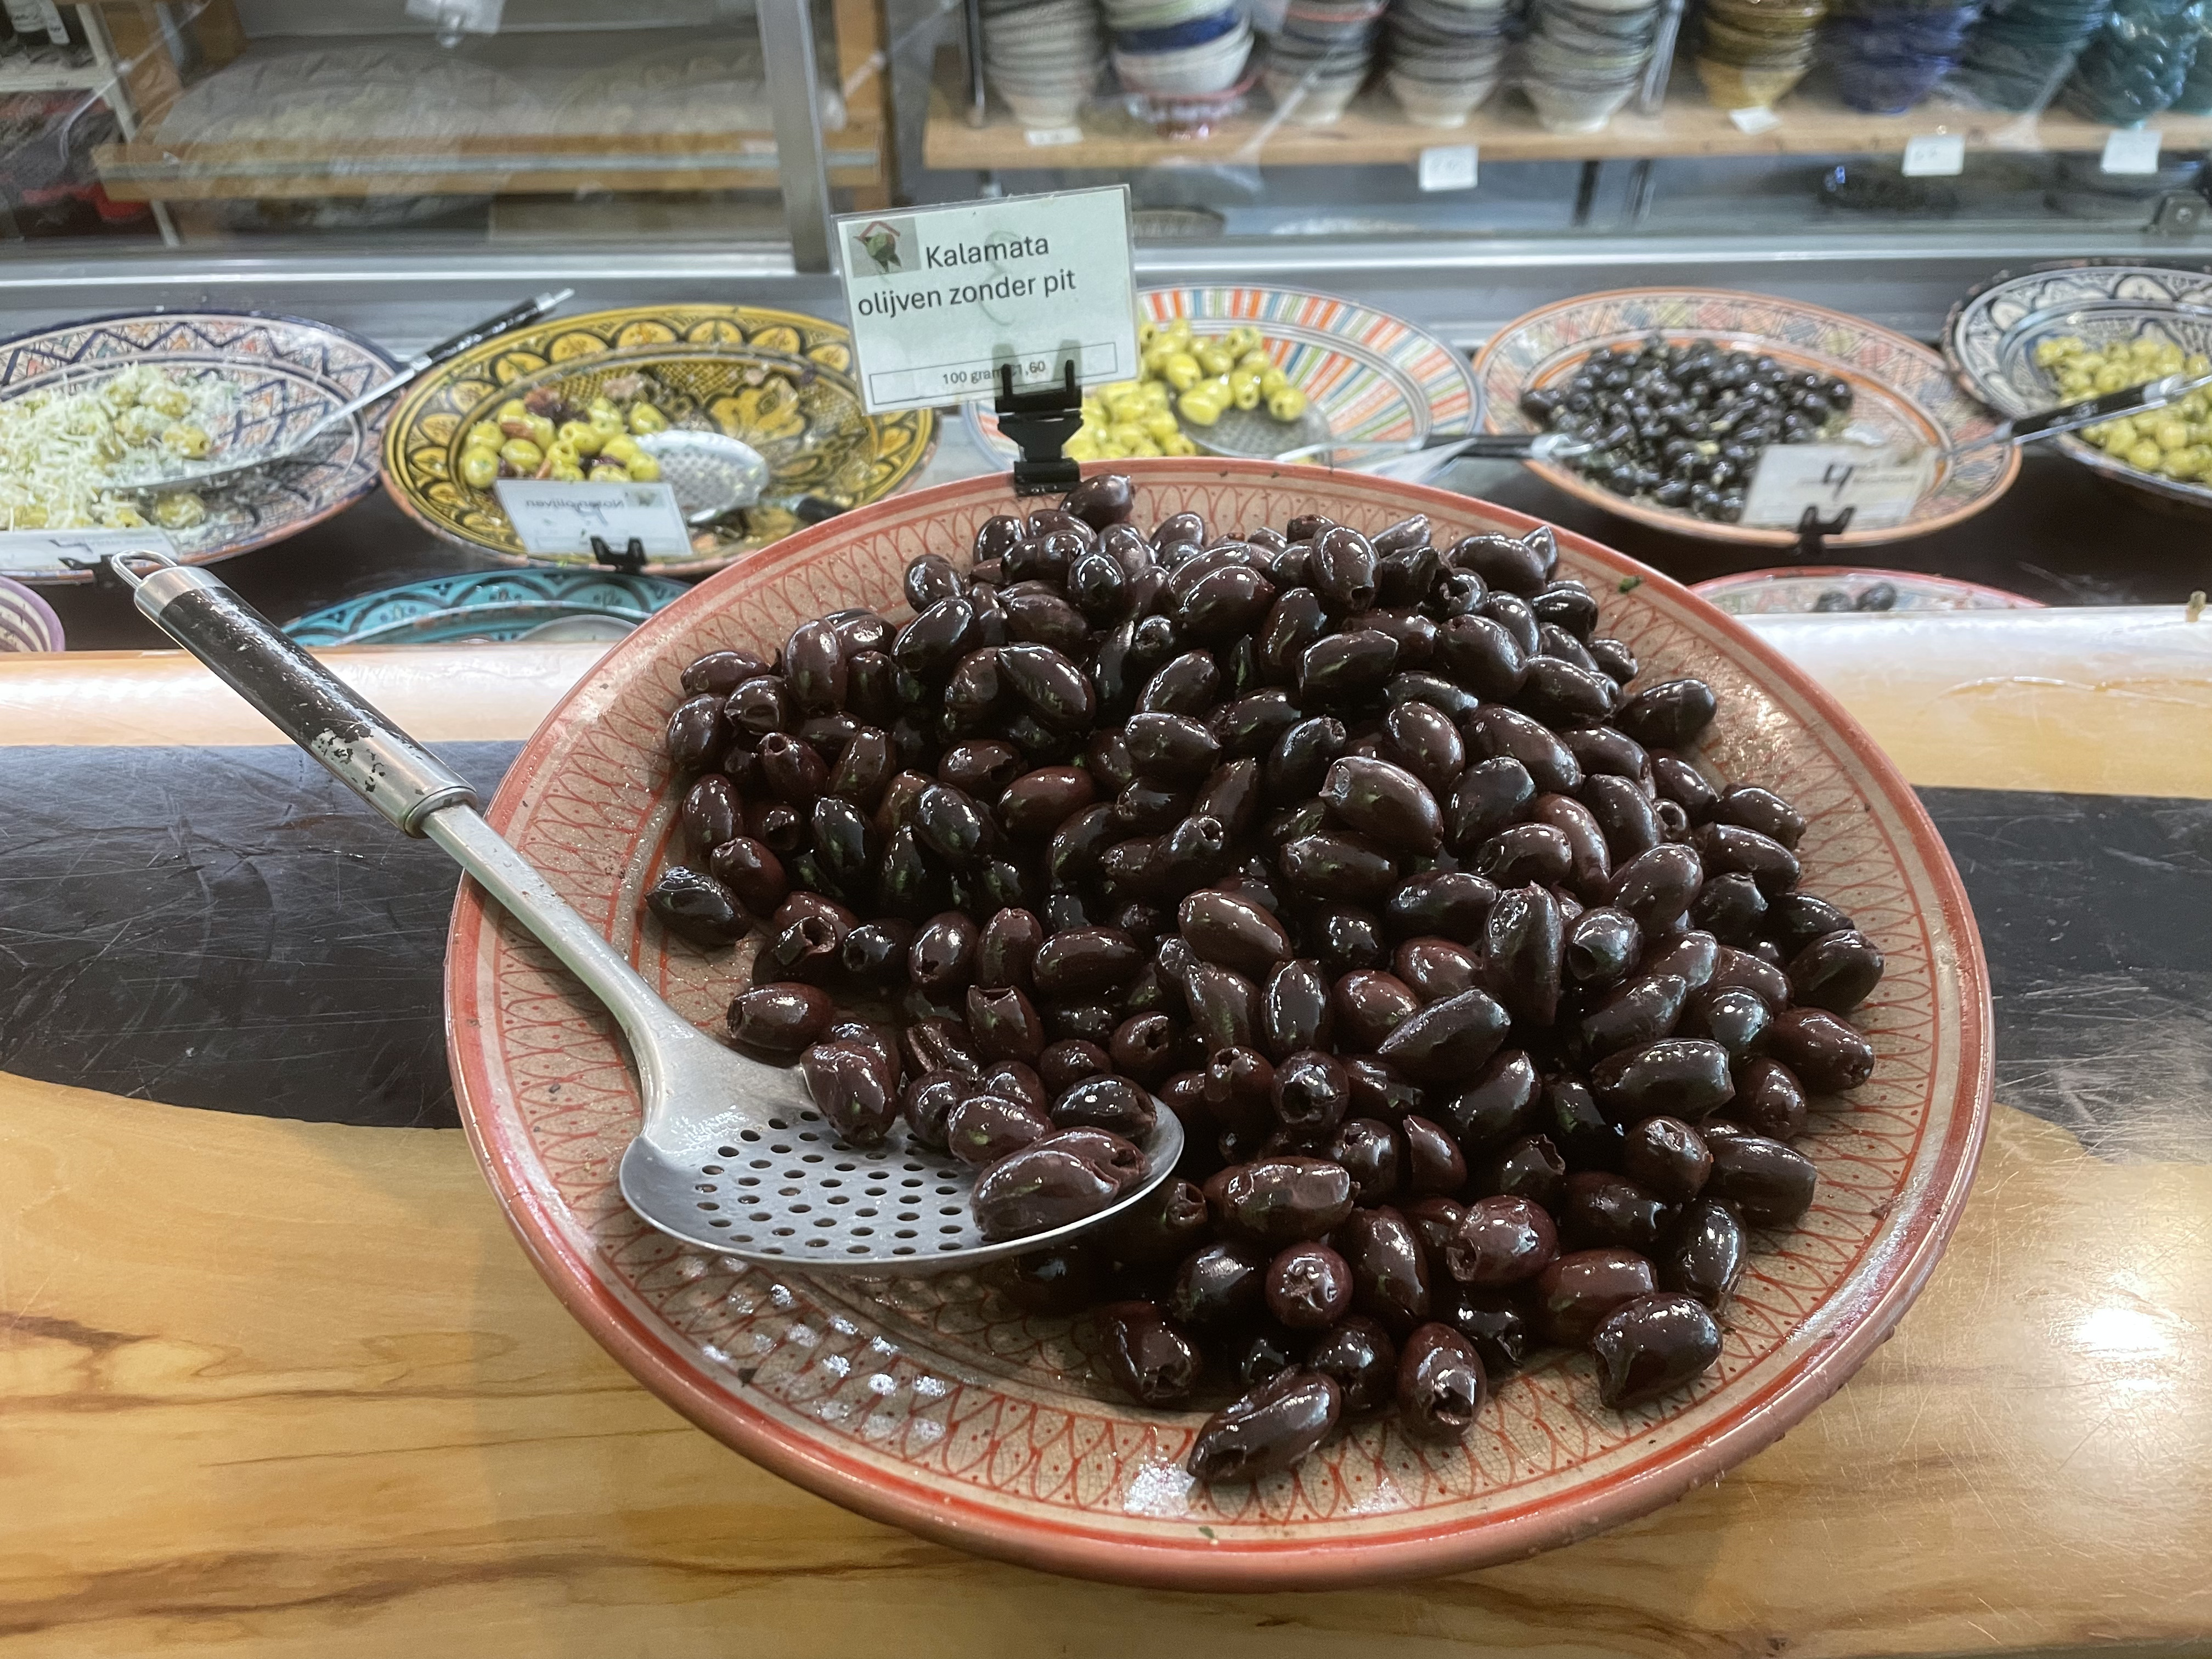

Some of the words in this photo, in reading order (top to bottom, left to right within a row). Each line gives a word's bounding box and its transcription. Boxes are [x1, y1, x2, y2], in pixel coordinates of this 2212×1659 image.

[926, 235, 1049, 269] Kalamata
[858, 289, 943, 318] olijven
[950, 276, 1036, 306] zonder
[1043, 268, 1077, 298] pit
[943, 371, 967, 385] 100
